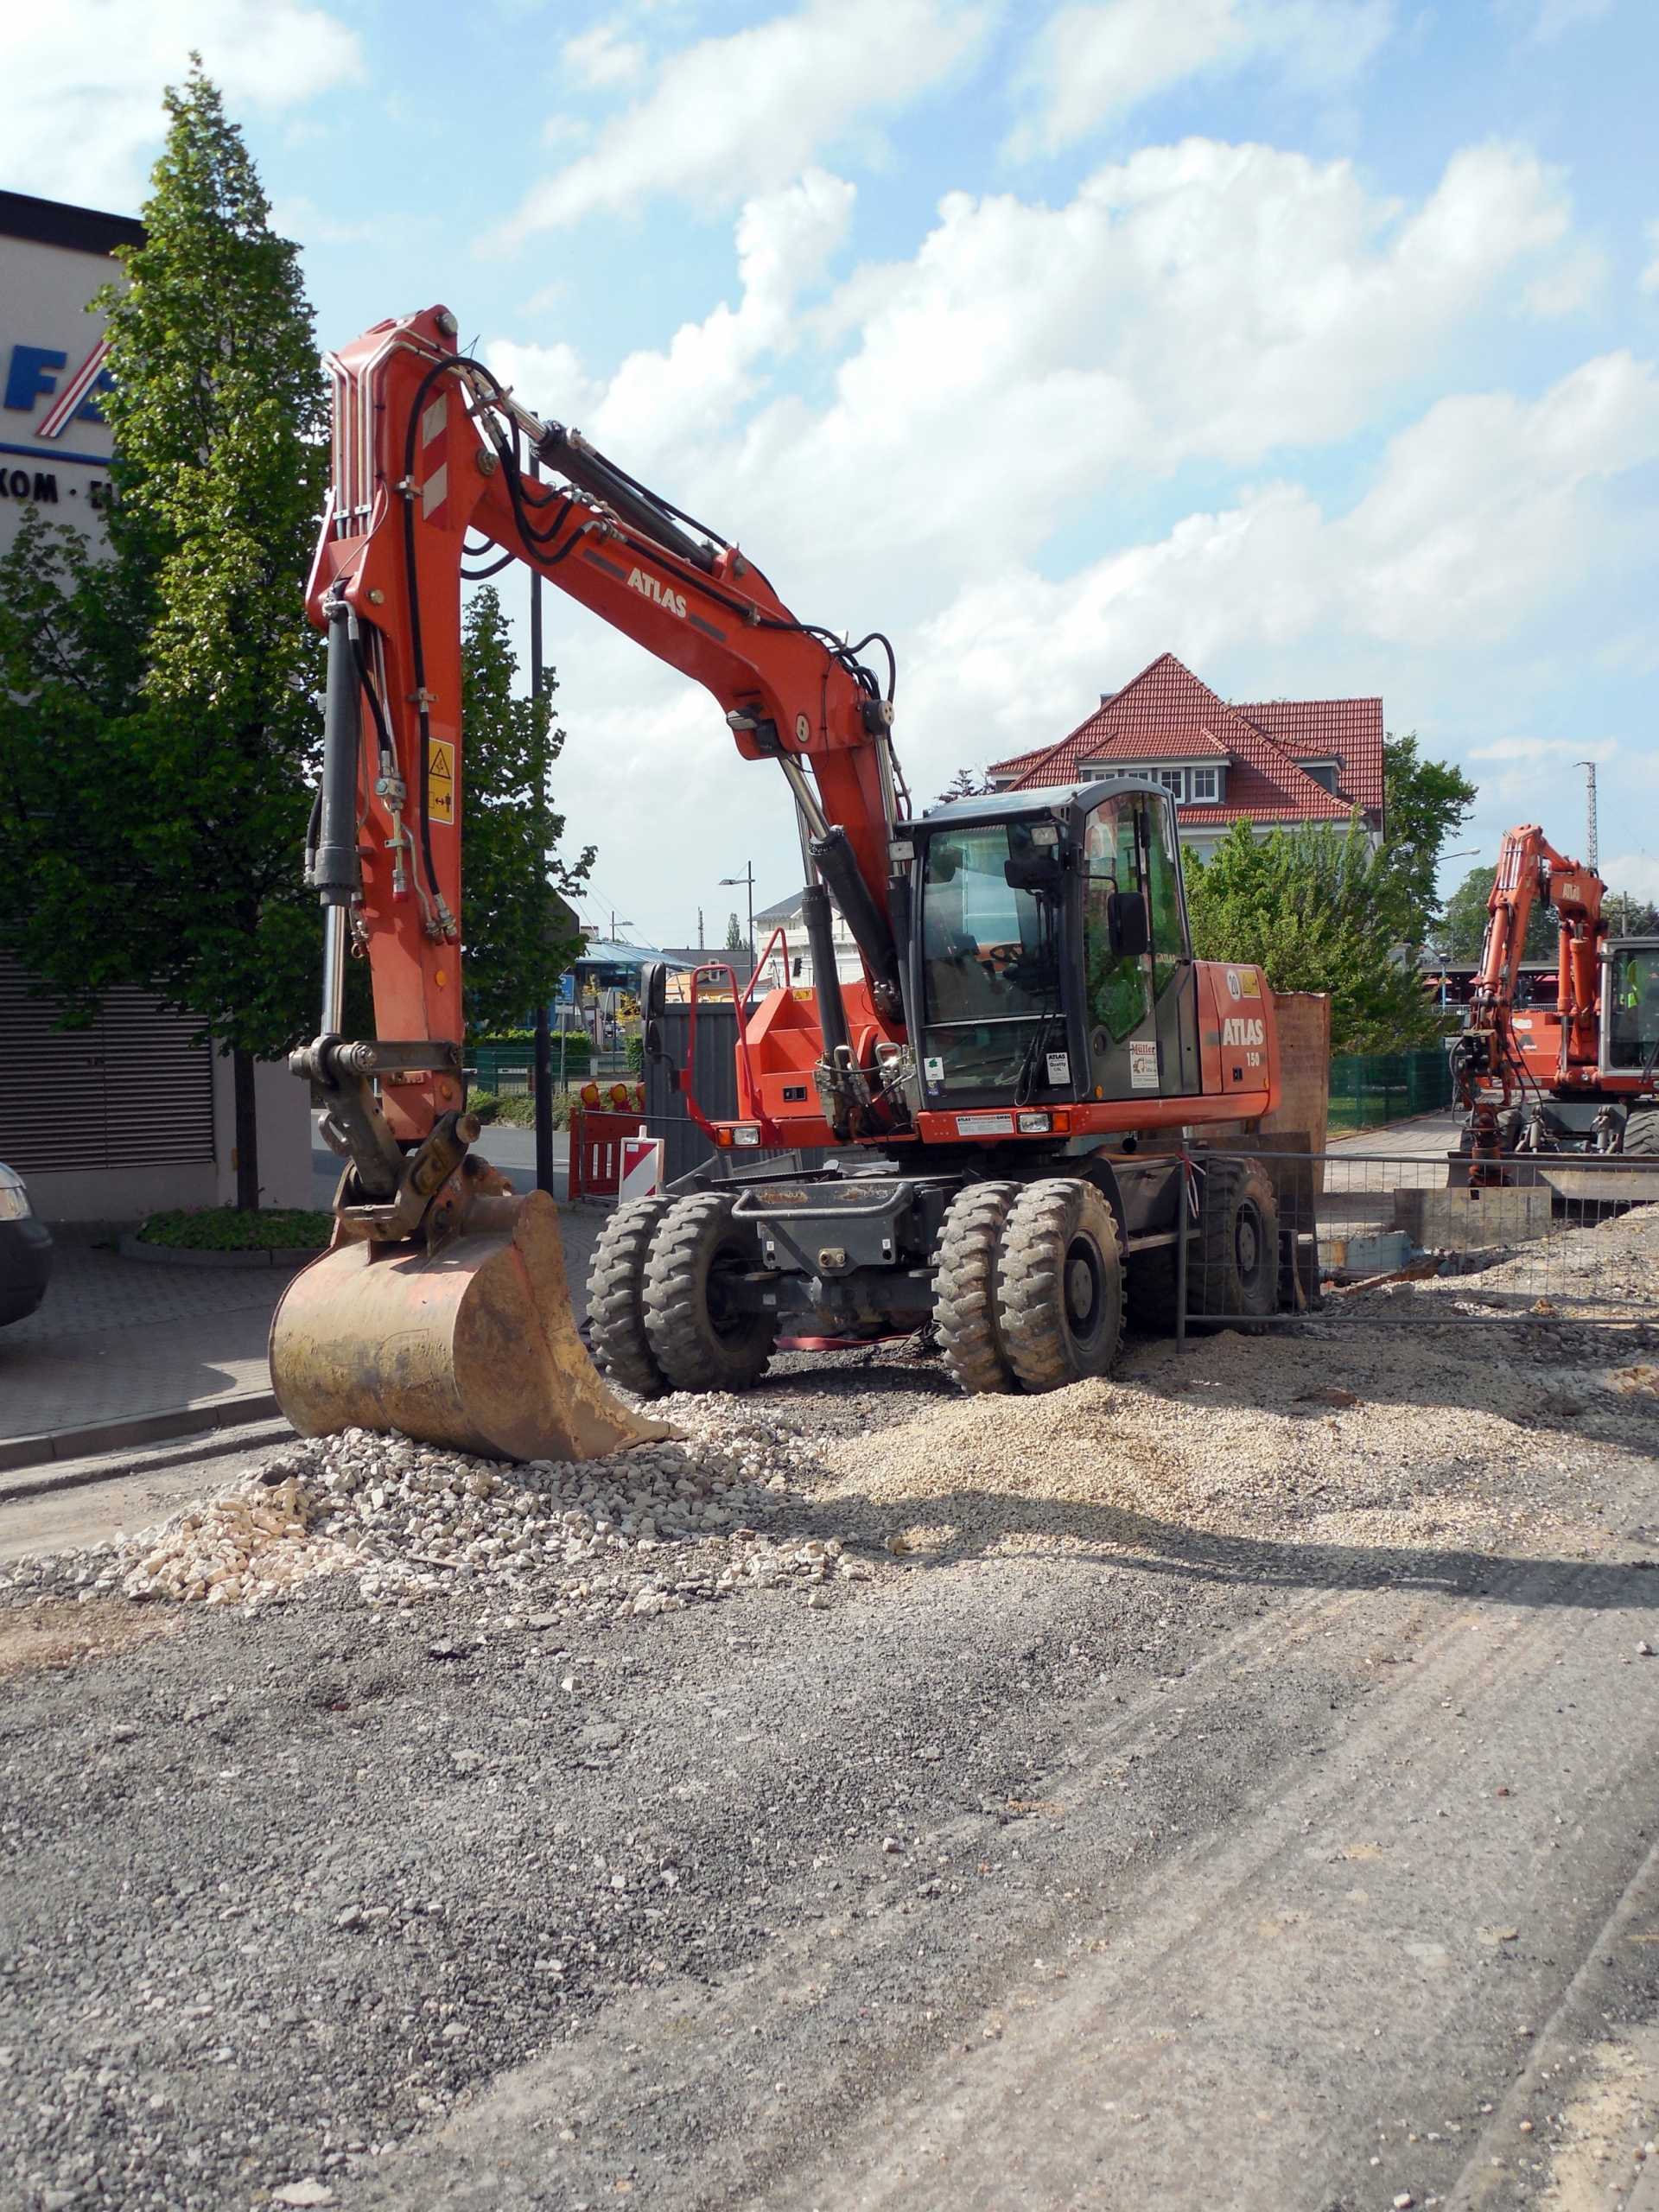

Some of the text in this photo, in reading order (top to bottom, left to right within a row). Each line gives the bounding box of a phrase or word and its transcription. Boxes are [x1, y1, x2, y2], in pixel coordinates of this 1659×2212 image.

[626, 567, 687, 618] ATLAS
[1562, 882, 1580, 901] ATLAS
[1228, 975, 1239, 995] 20
[1223, 1018, 1263, 1046] ATLAS
[1131, 1044, 1155, 1053] Müller
[1247, 1052, 1260, 1066] 150
